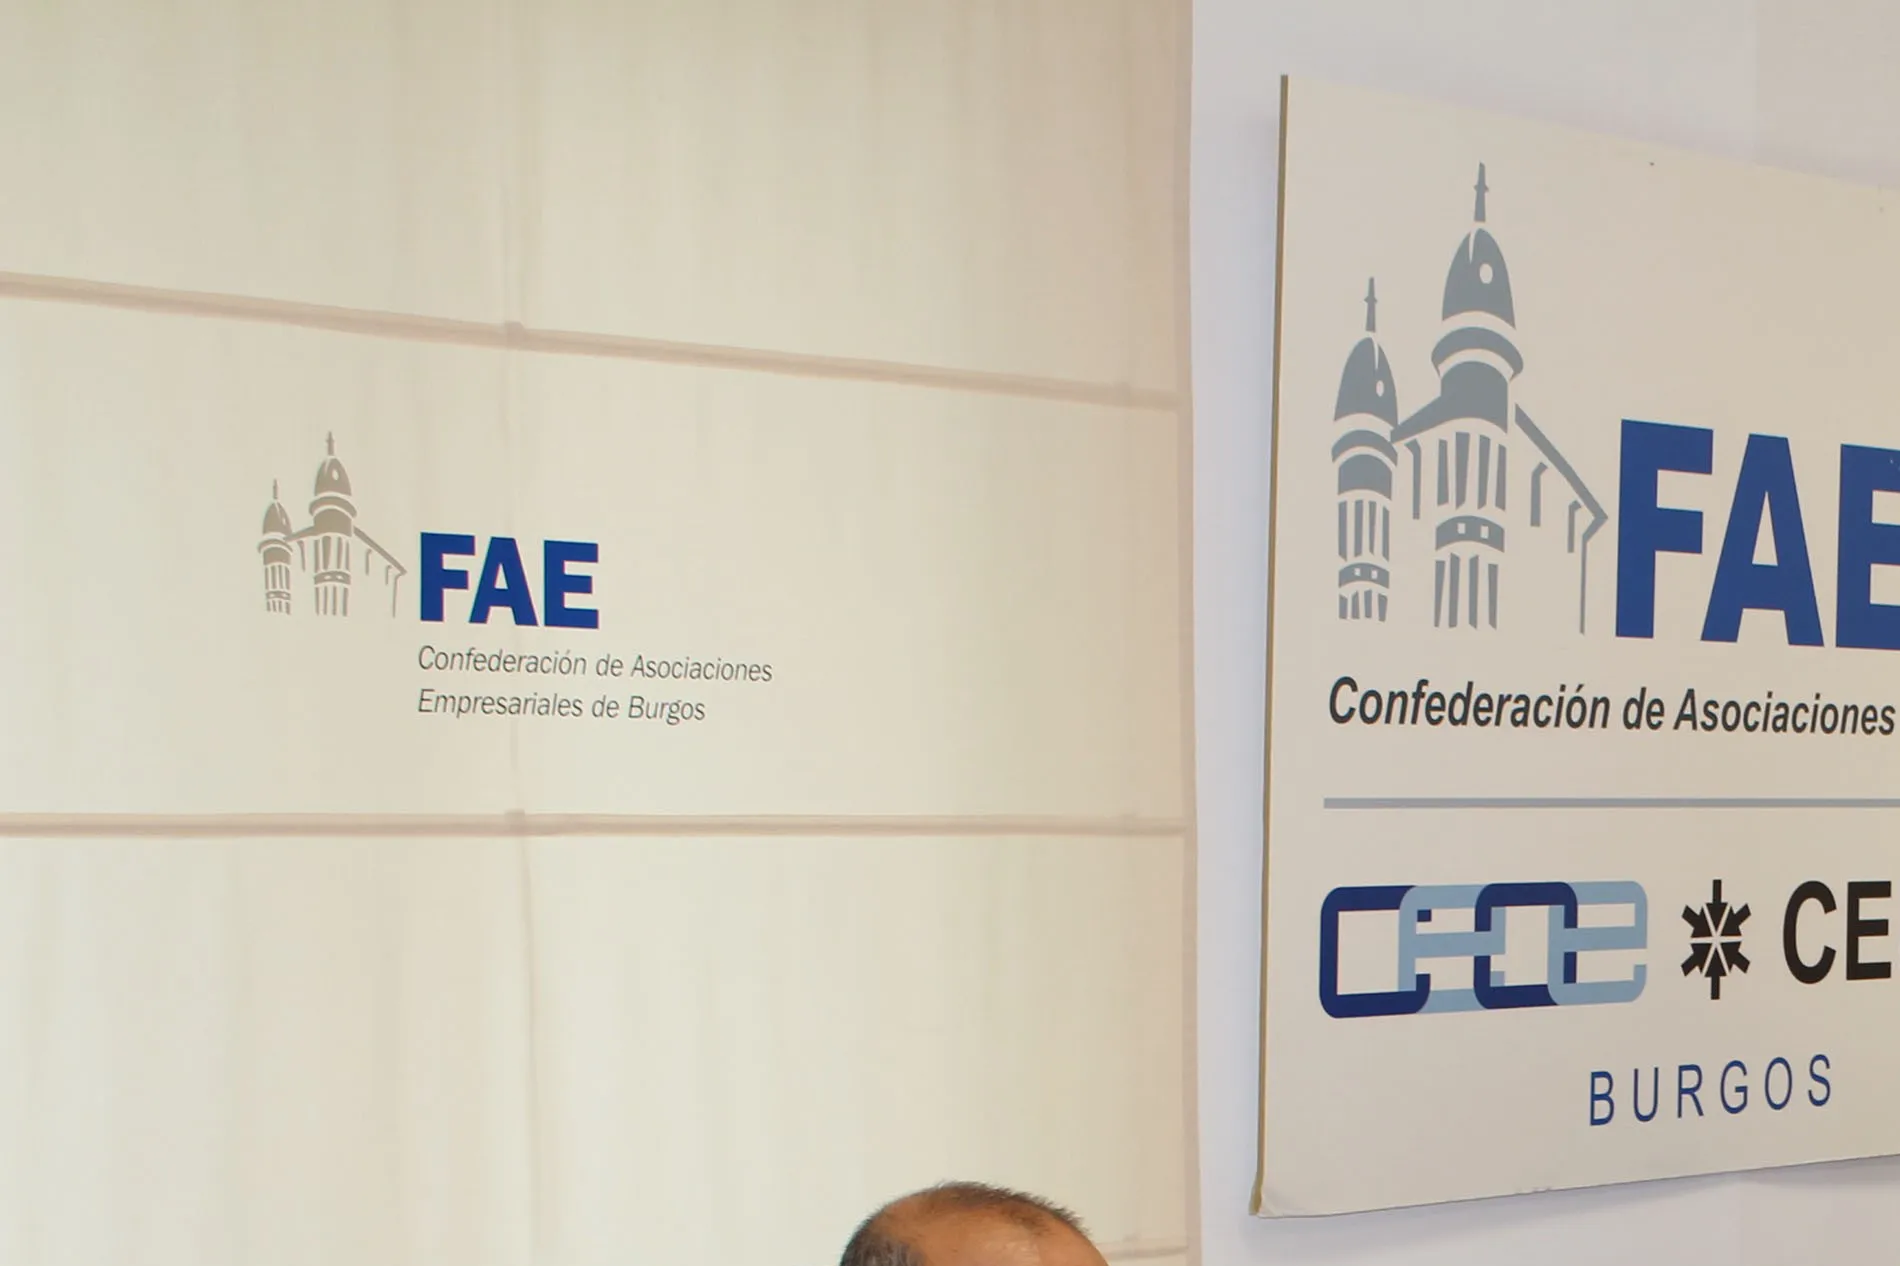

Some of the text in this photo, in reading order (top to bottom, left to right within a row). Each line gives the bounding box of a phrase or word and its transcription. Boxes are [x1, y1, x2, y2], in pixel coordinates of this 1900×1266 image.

[420, 531, 600, 630] FAE
[418, 645, 774, 683] Confederación de Asociaciones
[418, 688, 706, 726] Empresariales de Burgos
[1328, 676, 1610, 731] Confederación
[1622, 689, 1666, 733] de
[1674, 688, 1896, 739] Asociaciones
[1588, 1053, 1834, 1127] BURGOS
